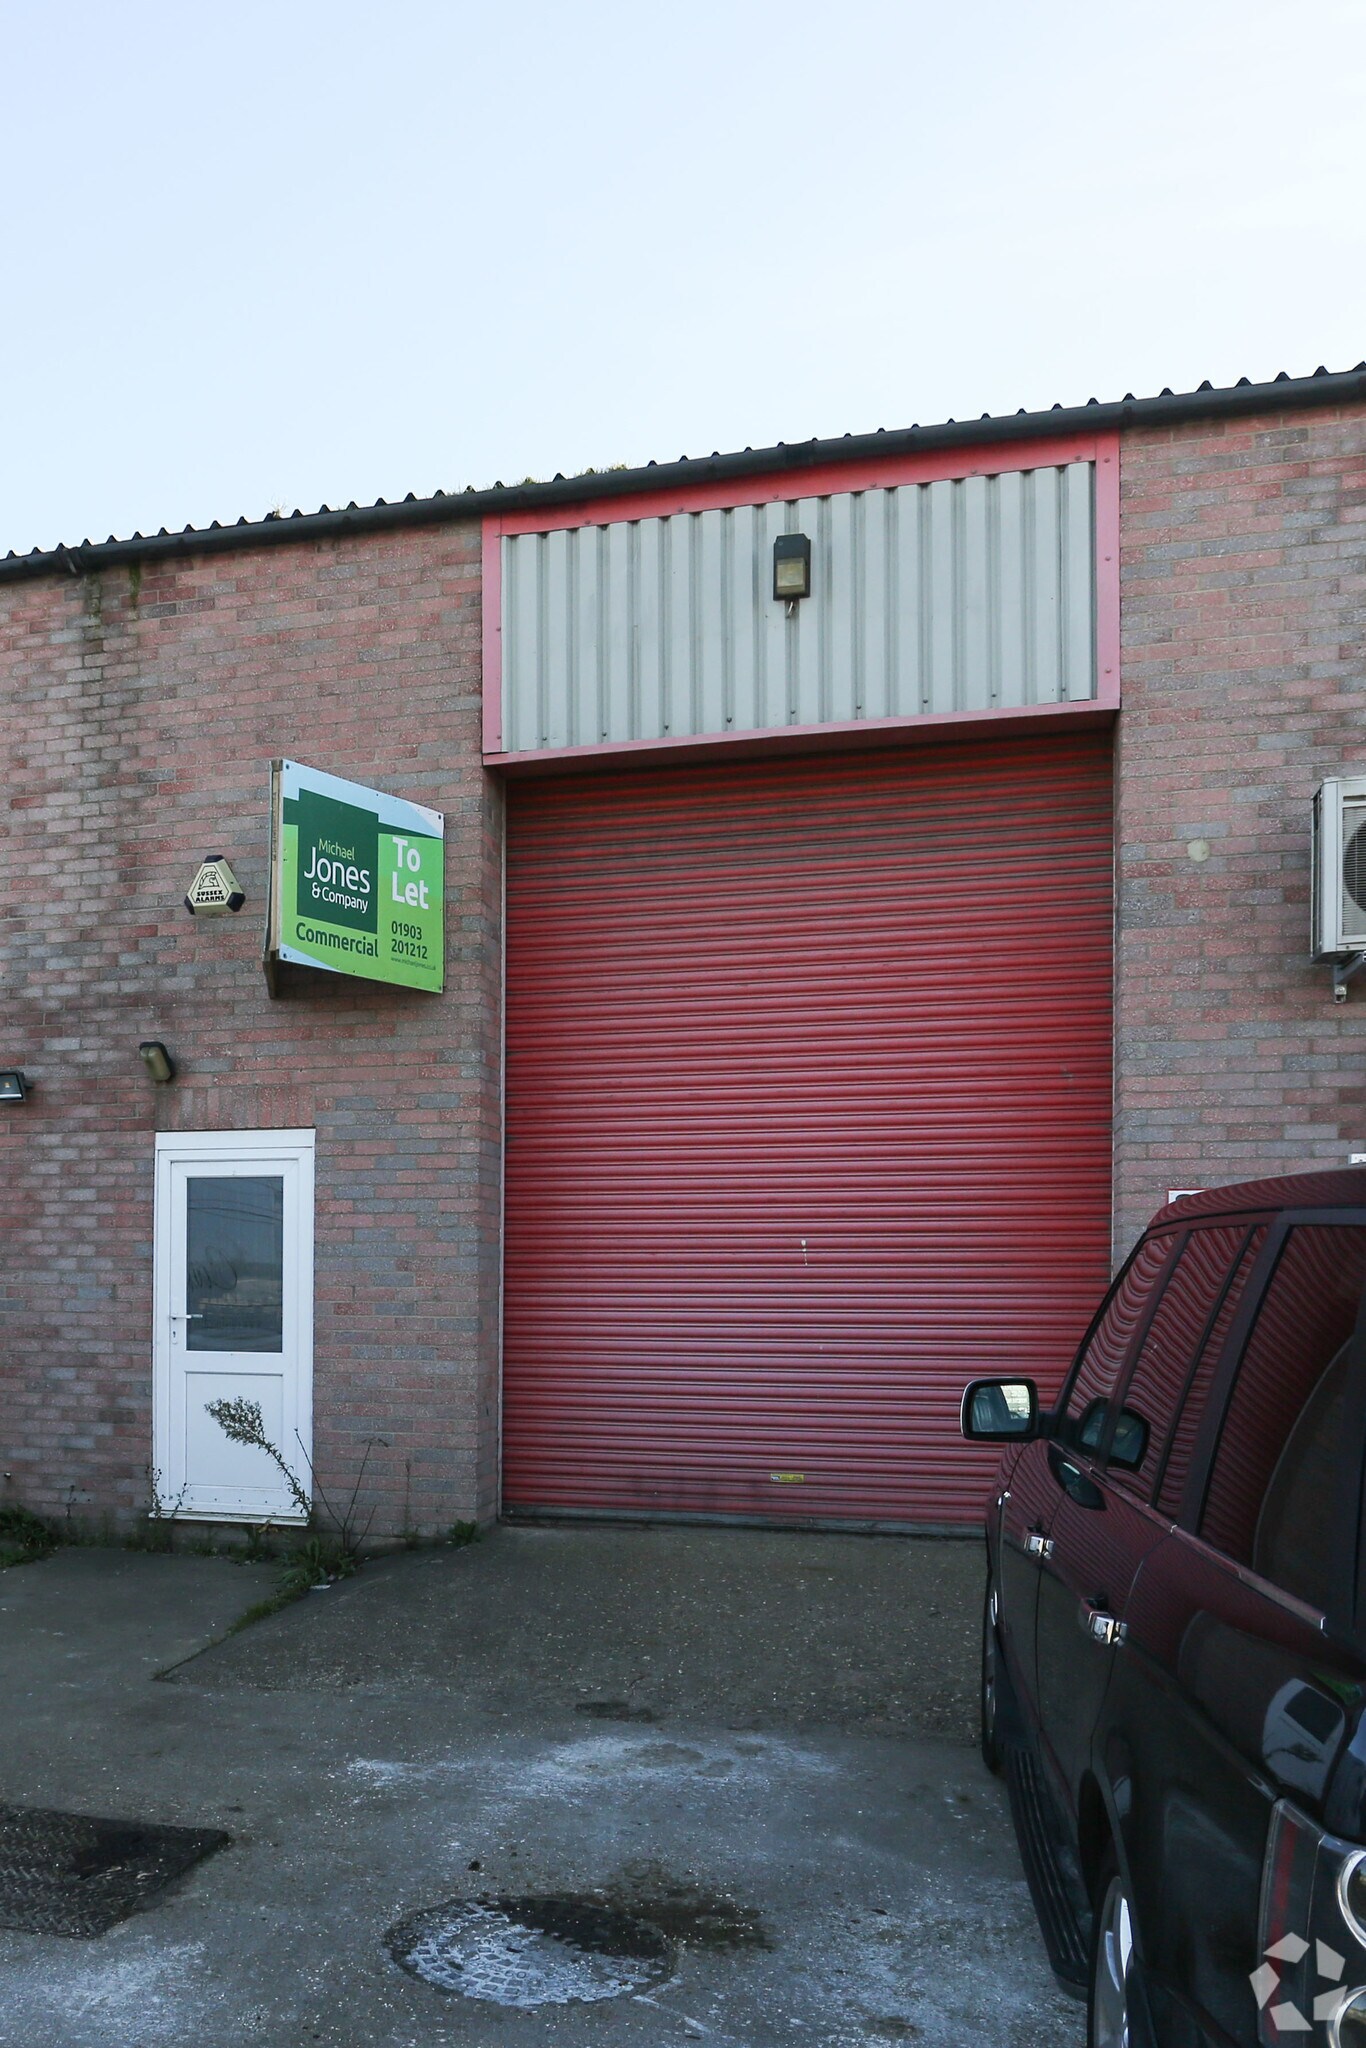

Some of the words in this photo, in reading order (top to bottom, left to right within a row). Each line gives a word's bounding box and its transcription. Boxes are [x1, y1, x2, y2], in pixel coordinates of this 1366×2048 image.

[318, 838, 355, 860] Michael
[392, 836, 421, 872] To
[304, 846, 371, 893] Jones
[196, 889, 223, 897] SUSSEX
[321, 887, 368, 913] Company
[391, 871, 429, 909] Let
[296, 922, 379, 957] Commercial
[391, 920, 423, 941] 01903
[391, 938, 428, 960] 201212
